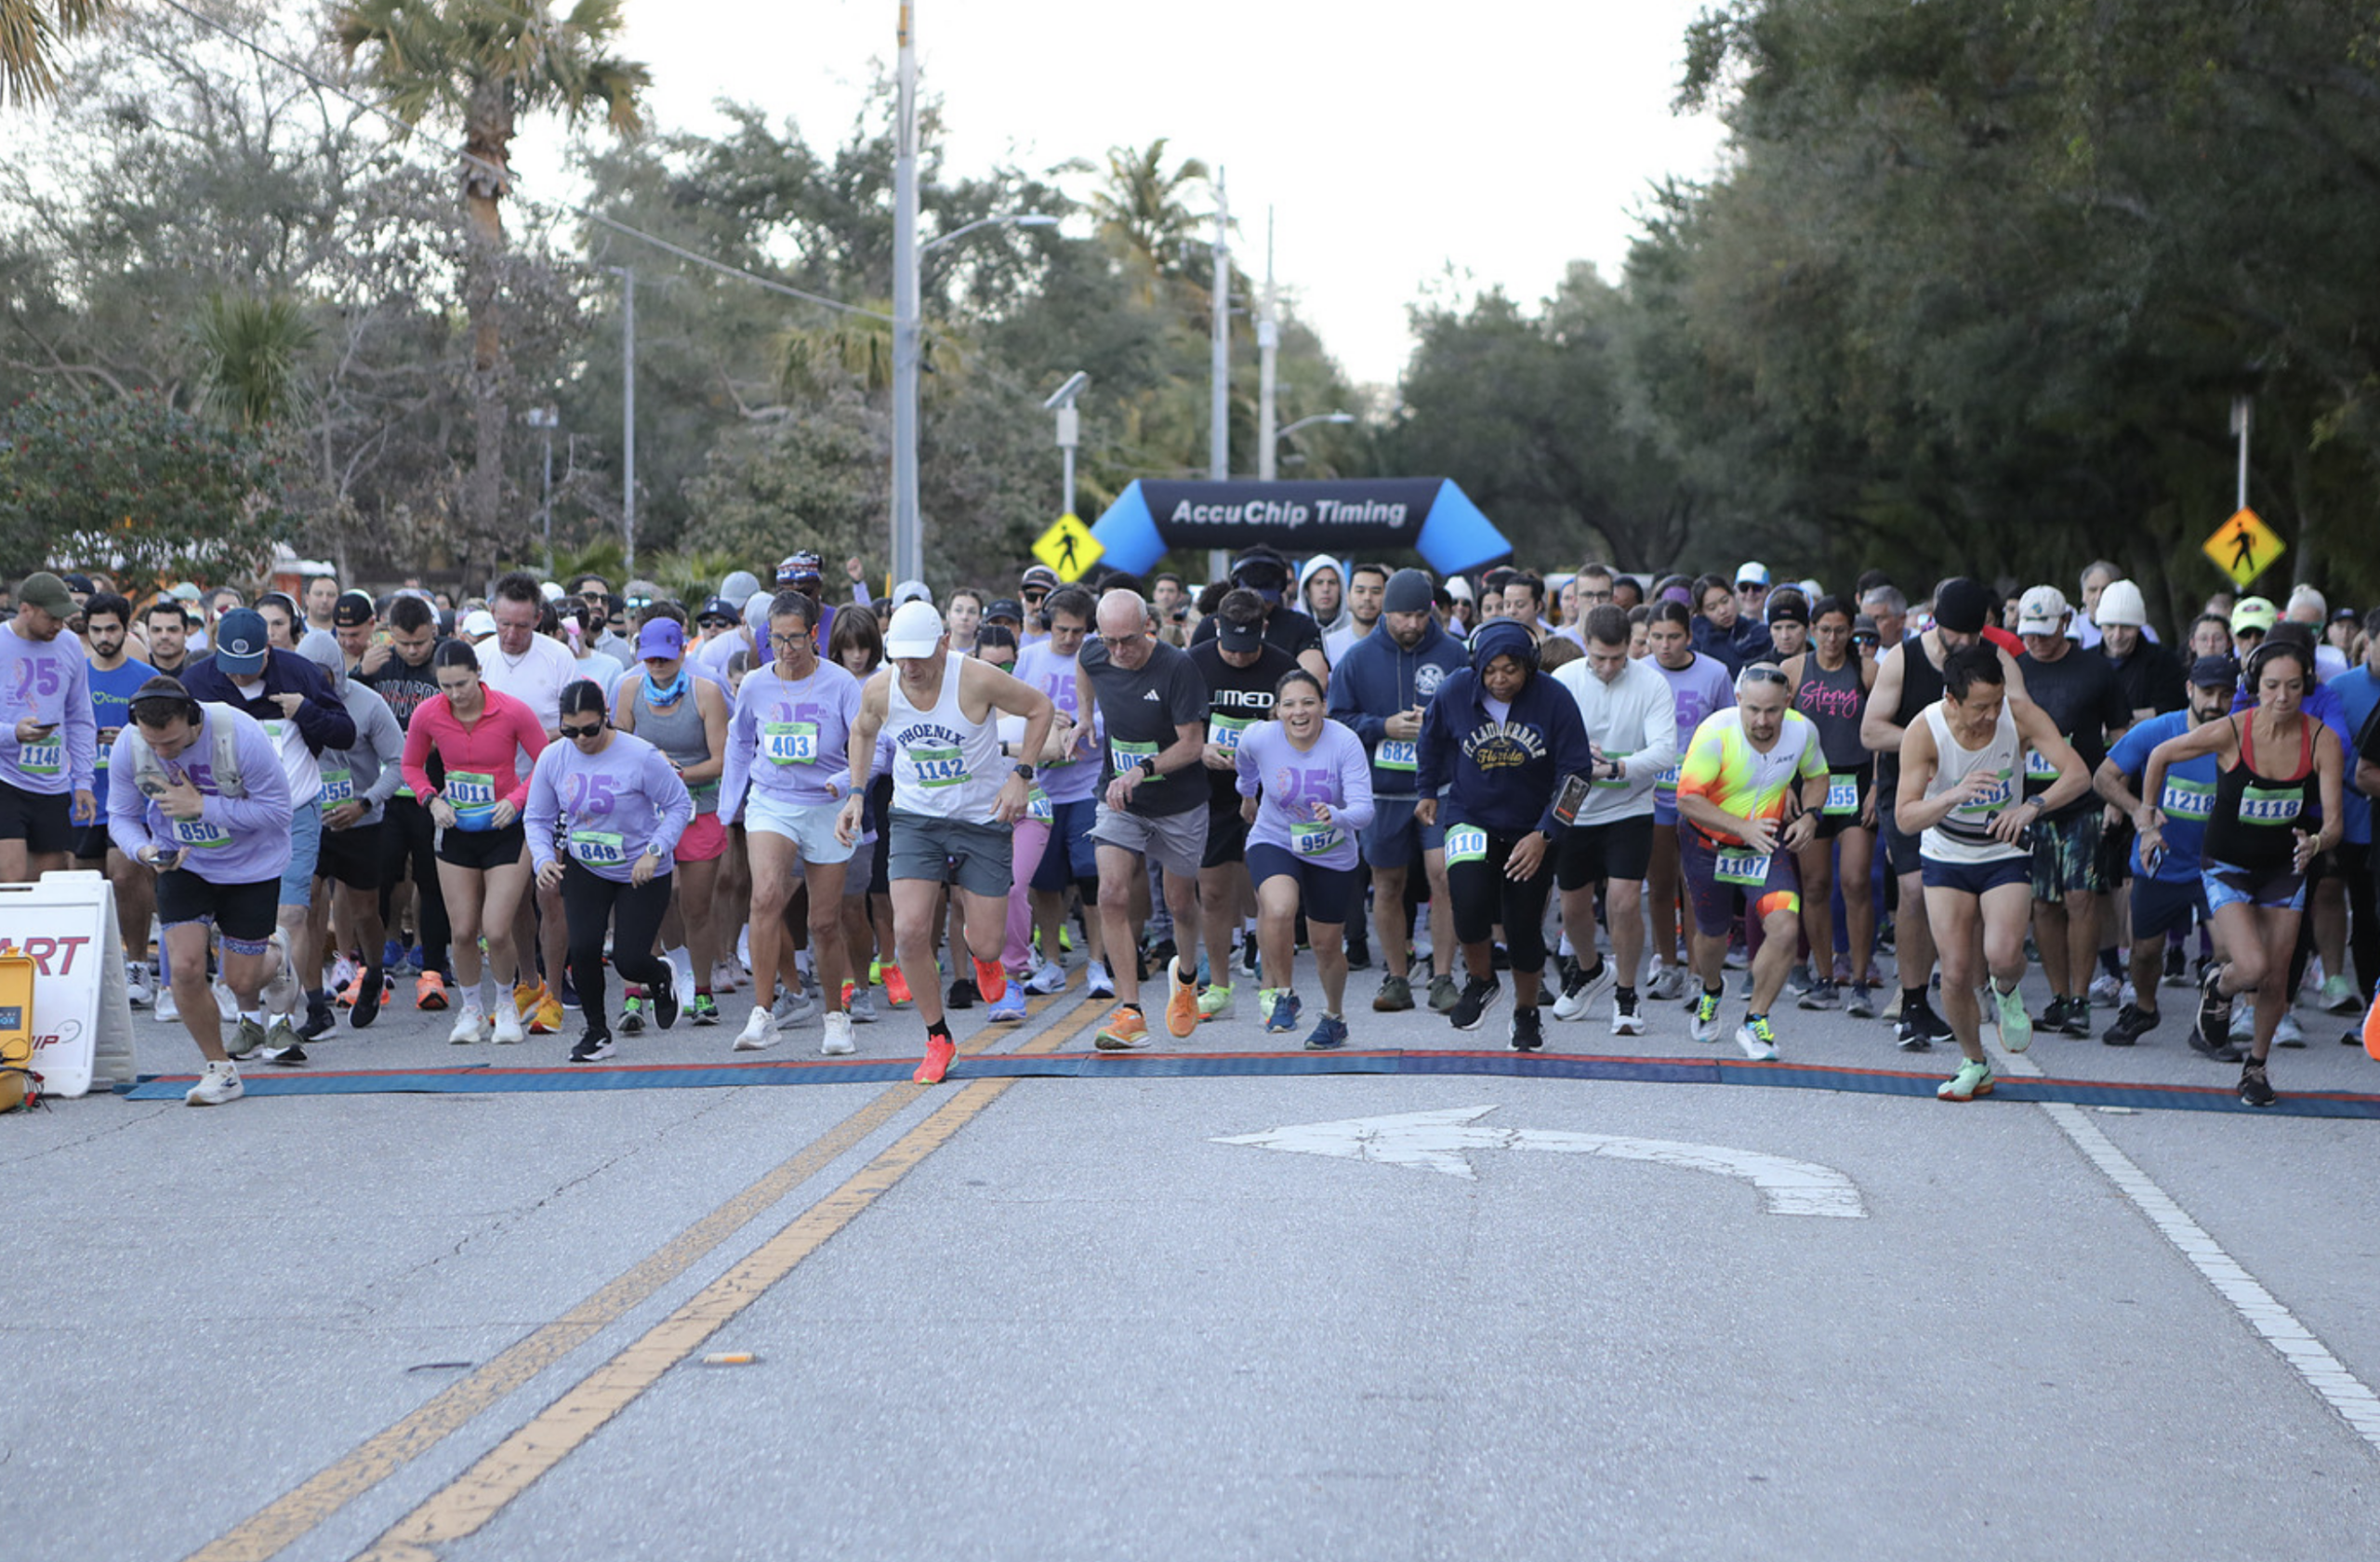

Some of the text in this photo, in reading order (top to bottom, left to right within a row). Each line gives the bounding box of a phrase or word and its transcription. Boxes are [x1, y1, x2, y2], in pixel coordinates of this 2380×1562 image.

[1171, 499, 1408, 528] AccuChip Timing
[1800, 680, 1860, 719] Strong
[897, 723, 967, 748] PHOENIX
[773, 736, 809, 757] 403
[1382, 741, 1415, 761] 682
[915, 758, 968, 780] 1142
[449, 781, 492, 802] 1011
[2168, 789, 2215, 813] 1218
[2244, 801, 2300, 817] 1118
[178, 822, 219, 841] 850
[1302, 828, 1336, 852] 957
[580, 842, 618, 860] 848
[1720, 857, 1766, 876] 1107
